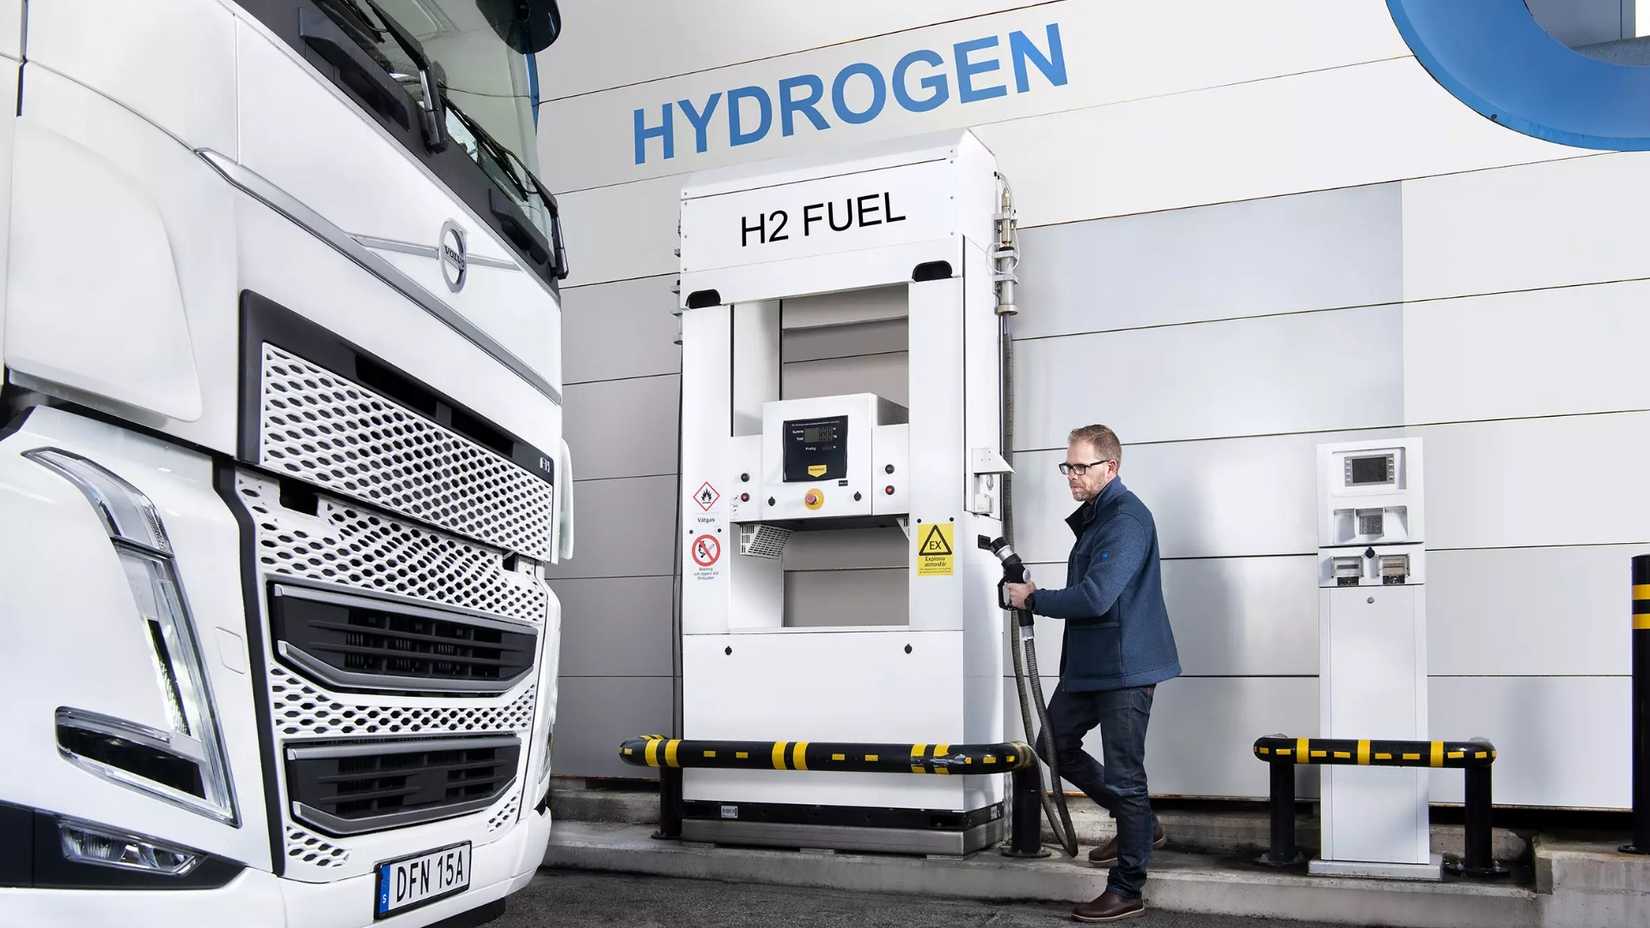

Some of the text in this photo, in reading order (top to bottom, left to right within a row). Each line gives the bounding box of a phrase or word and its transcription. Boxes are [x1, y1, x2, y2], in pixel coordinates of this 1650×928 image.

[633, 23, 1068, 165] HYDROGEN
[741, 192, 906, 247] H2 FUEL
[929, 540, 941, 550] EX
[382, 894, 387, 904] S
[396, 850, 463, 902] DFN 15A
